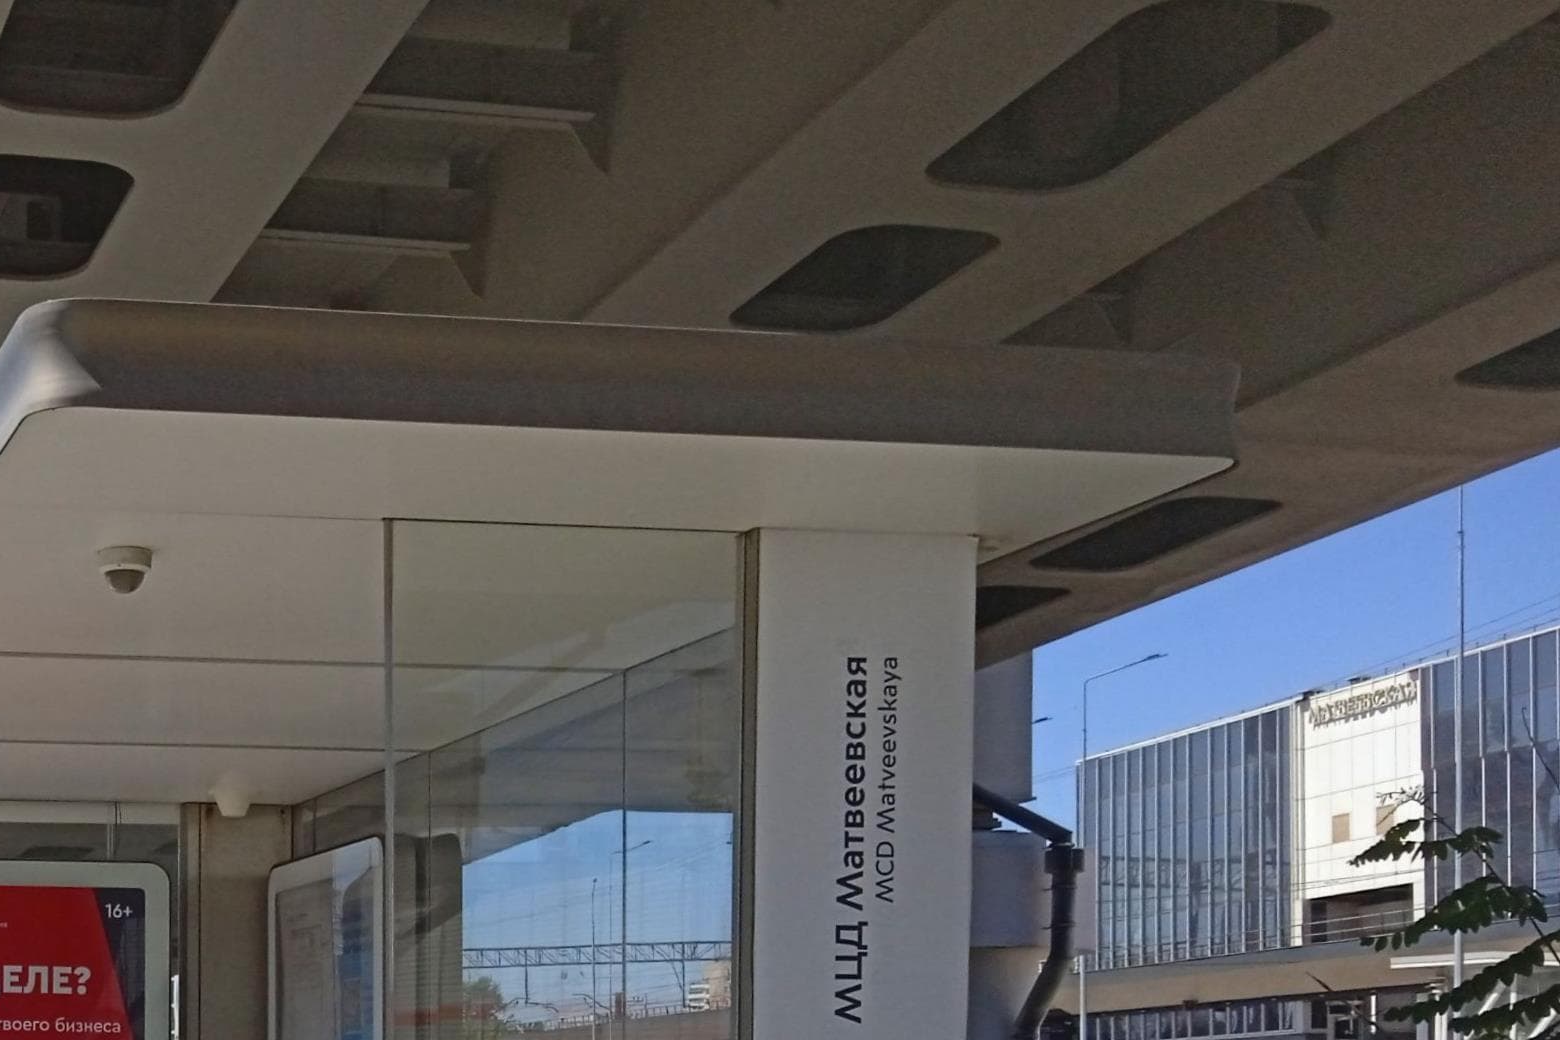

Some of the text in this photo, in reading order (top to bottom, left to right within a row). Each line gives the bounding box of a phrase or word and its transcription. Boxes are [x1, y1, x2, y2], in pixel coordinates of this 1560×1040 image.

[834, 656, 869, 1024] МЦД Матвеевская
[875, 656, 902, 903] MCD Matveevskaya
[104, 903, 133, 919] 16+
[55, 1017, 121, 1034] бизнеса
